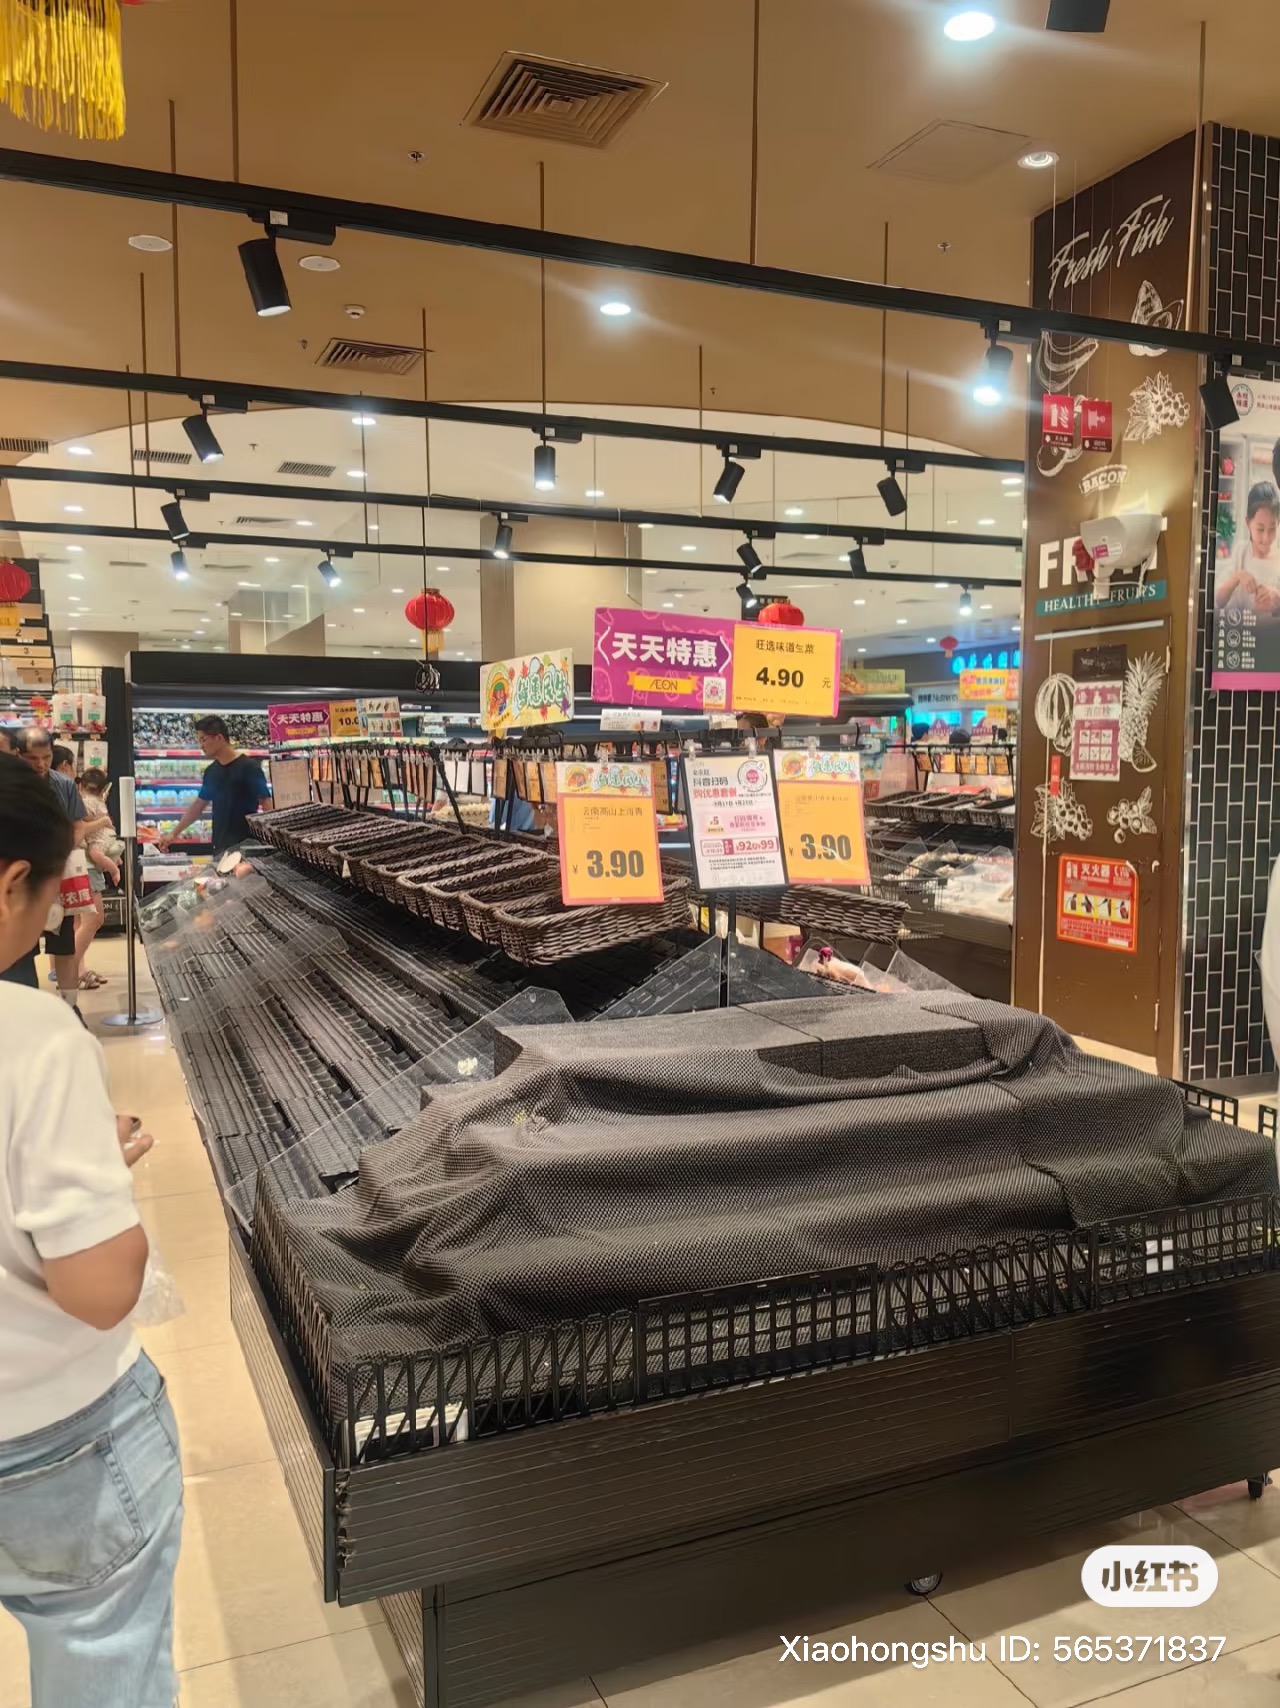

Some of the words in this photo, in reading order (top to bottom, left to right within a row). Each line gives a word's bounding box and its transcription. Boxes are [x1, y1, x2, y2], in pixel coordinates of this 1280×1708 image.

[1047, 231, 1114, 300] Fresh
[1115, 194, 1175, 268] Fish
[1081, 471, 1127, 493] BACON
[15, 628, 22, 637] 2
[23, 647, 30, 655] 3
[611, 631, 718, 668] 天天特惠
[30, 659, 35, 667] 4
[756, 666, 805, 689] 4.90
[821, 676, 832, 689] 元
[276, 711, 325, 725] 天天特惠
[800, 833, 852, 861] 3.90
[586, 850, 645, 878] 3.90
